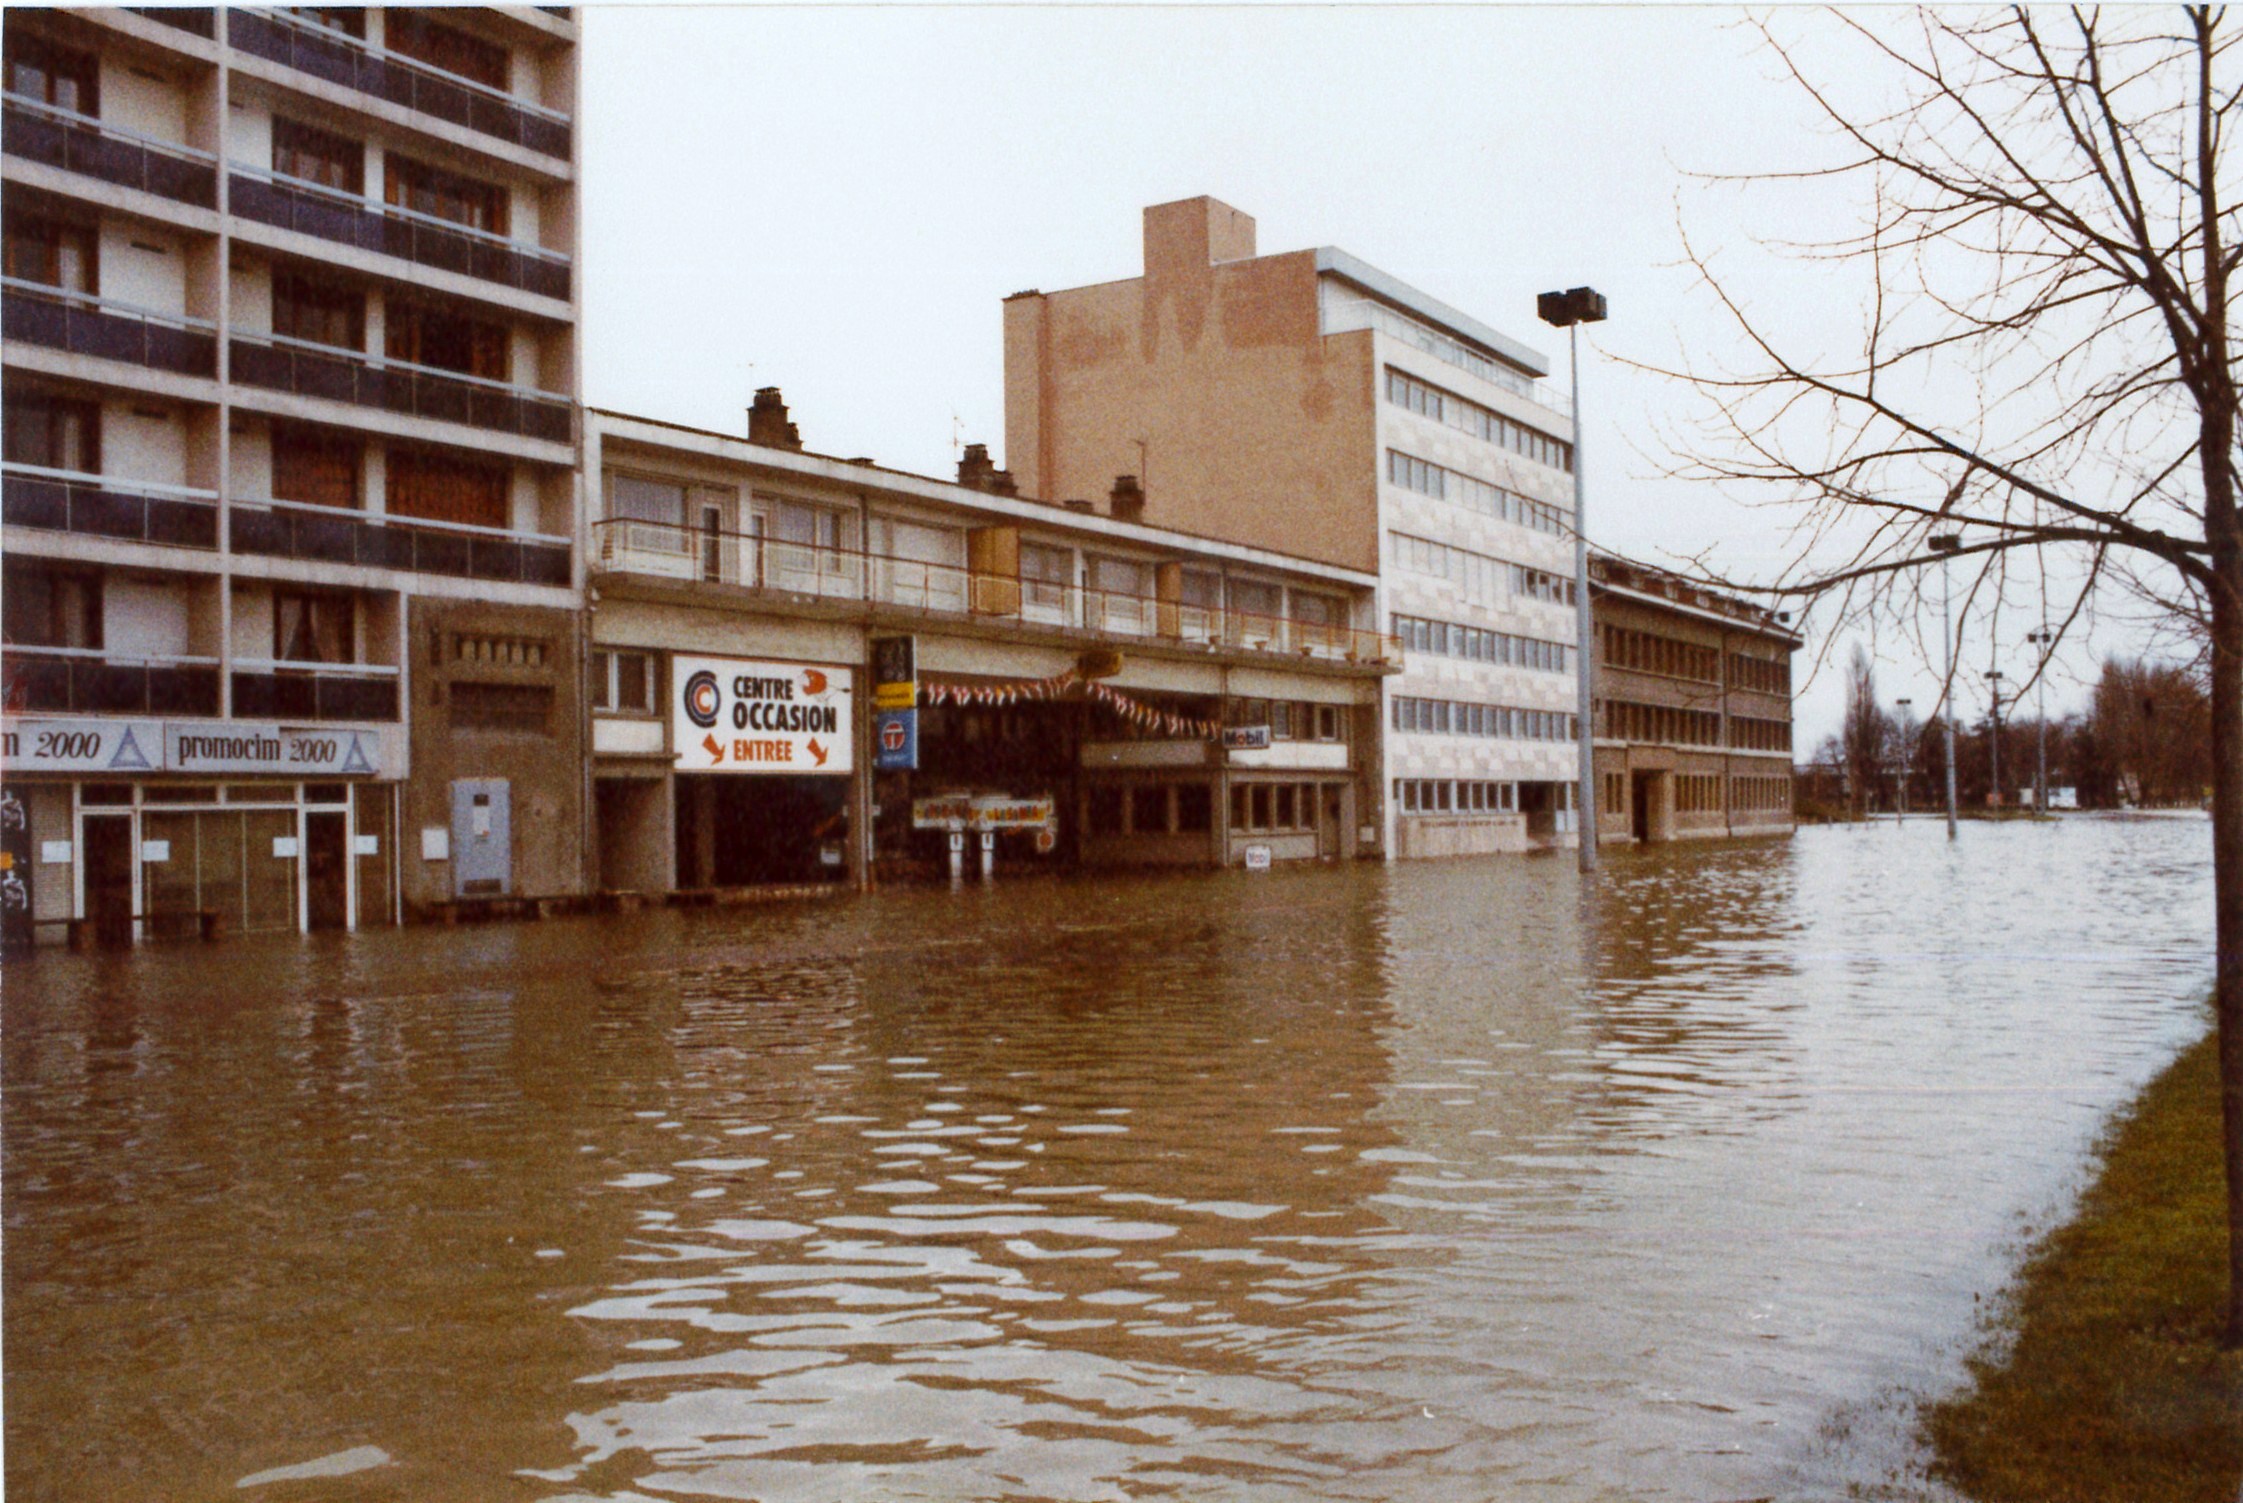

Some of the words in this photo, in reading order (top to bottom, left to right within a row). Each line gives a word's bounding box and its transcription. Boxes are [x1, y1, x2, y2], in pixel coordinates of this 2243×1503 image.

[733, 676, 793, 700] CENTRE
[732, 701, 836, 733] OCCASION
[35, 732, 101, 758] 2000
[179, 733, 280, 765] promocim
[290, 739, 337, 762] 2000
[1225, 730, 1263, 746] Mobil
